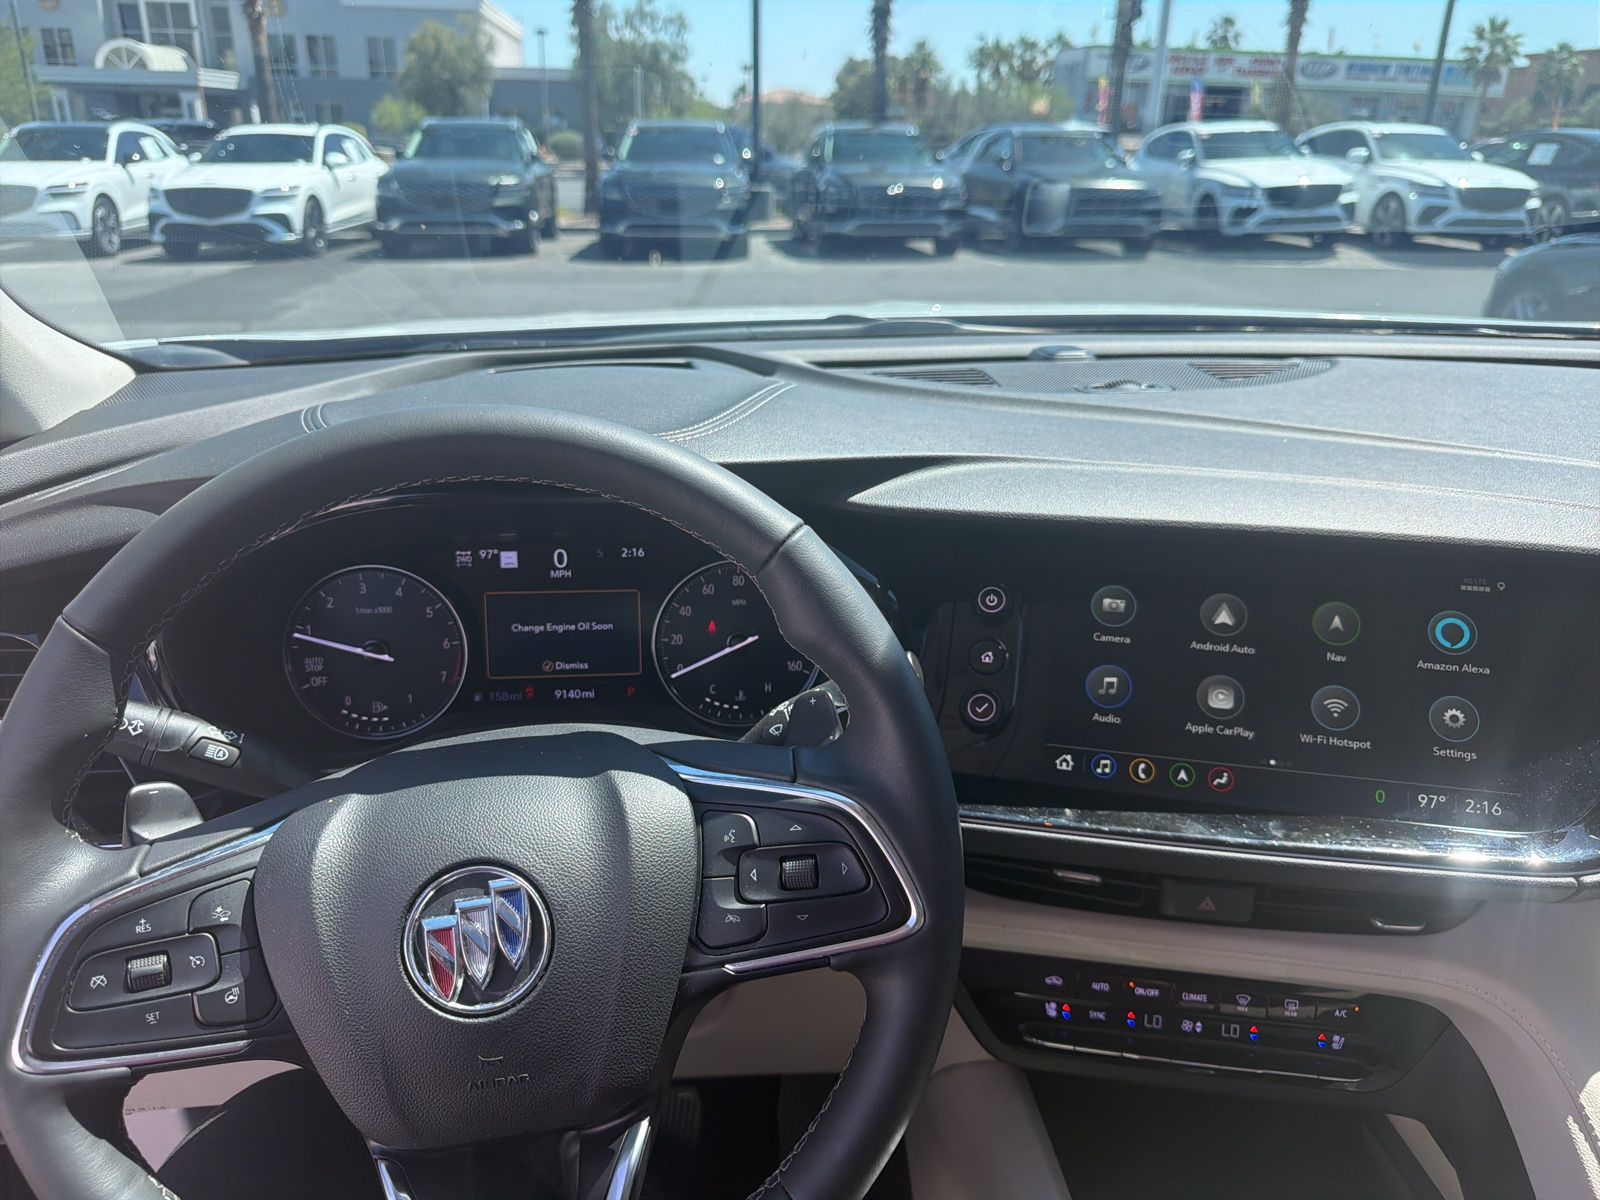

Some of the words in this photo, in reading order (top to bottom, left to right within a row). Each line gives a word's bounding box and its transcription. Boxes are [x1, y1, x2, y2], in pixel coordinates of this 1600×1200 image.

[479, 549, 499, 559] 97°
[553, 548, 568, 568] 0
[621, 547, 645, 558] 2:16
[550, 569, 572, 578] MPH
[732, 575, 745, 586] 80
[359, 583, 367, 594] 3
[395, 586, 403, 597] 4
[702, 584, 715, 595] 60
[327, 597, 335, 608] 2
[426, 606, 434, 618] 5
[678, 606, 692, 616] 40
[511, 623, 545, 634] Change
[546, 622, 576, 633] Engine
[577, 621, 590, 631] Oil
[591, 621, 613, 631] Soon
[443, 638, 450, 649] 6
[670, 634, 683, 645] 20
[1093, 632, 1131, 644] Camera
[1190, 640, 1229, 653] Android
[1231, 643, 1256, 655] Auto
[1326, 651, 1347, 663] Nav
[304, 664, 324, 672] STOP
[555, 661, 589, 670] Dismiss
[786, 660, 803, 672] 160
[1416, 660, 1460, 673] Amazon
[1461, 663, 1490, 675] Alexa
[310, 677, 328, 687] OFF
[441, 671, 448, 683] 7
[627, 686, 636, 697] P
[709, 684, 716, 695] C
[764, 683, 772, 693] H
[555, 688, 595, 700] 9140mi
[345, 695, 352, 706] 0
[1092, 712, 1122, 724] Audio
[1185, 722, 1214, 735] Apple
[1216, 725, 1255, 739] CarPlay
[1299, 733, 1327, 746] Wi-Fi
[1329, 736, 1371, 750] Hotspot
[1432, 746, 1477, 761] Settings
[1375, 789, 1385, 803] 0
[1417, 793, 1446, 809] 97°
[1465, 799, 1502, 816] 2:16
[135, 923, 152, 934] RES
[1091, 982, 1109, 991] AUTO
[1134, 987, 1160, 997] ON/OFF
[1182, 991, 1208, 1003] CLIMATE
[145, 1011, 160, 1022] SET
[1088, 1010, 1107, 1020] SYNC
[1334, 1009, 1348, 1018] A/C
[1143, 1014, 1162, 1029] LO
[1221, 1023, 1240, 1038] LO
